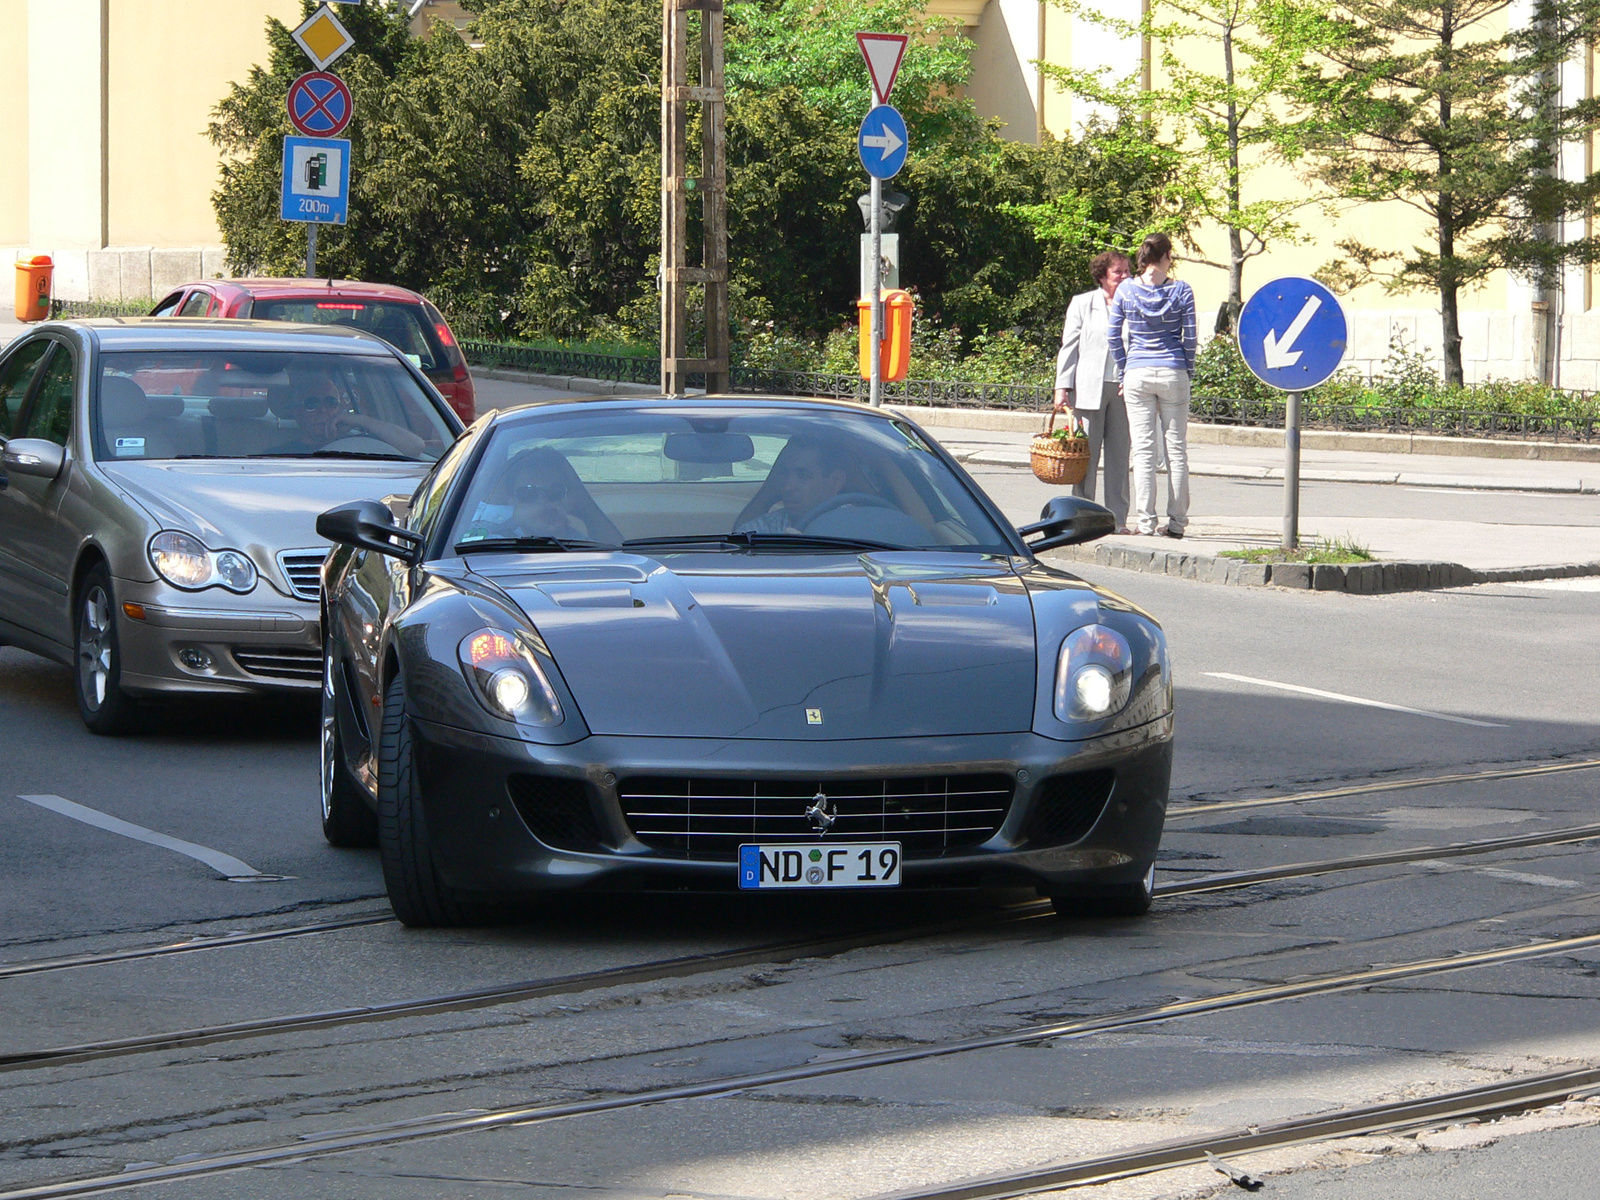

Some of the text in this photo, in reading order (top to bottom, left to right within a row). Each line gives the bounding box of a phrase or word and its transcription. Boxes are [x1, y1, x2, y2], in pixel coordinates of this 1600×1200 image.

[746, 870, 754, 881] D
[759, 849, 898, 882] ND F 19
